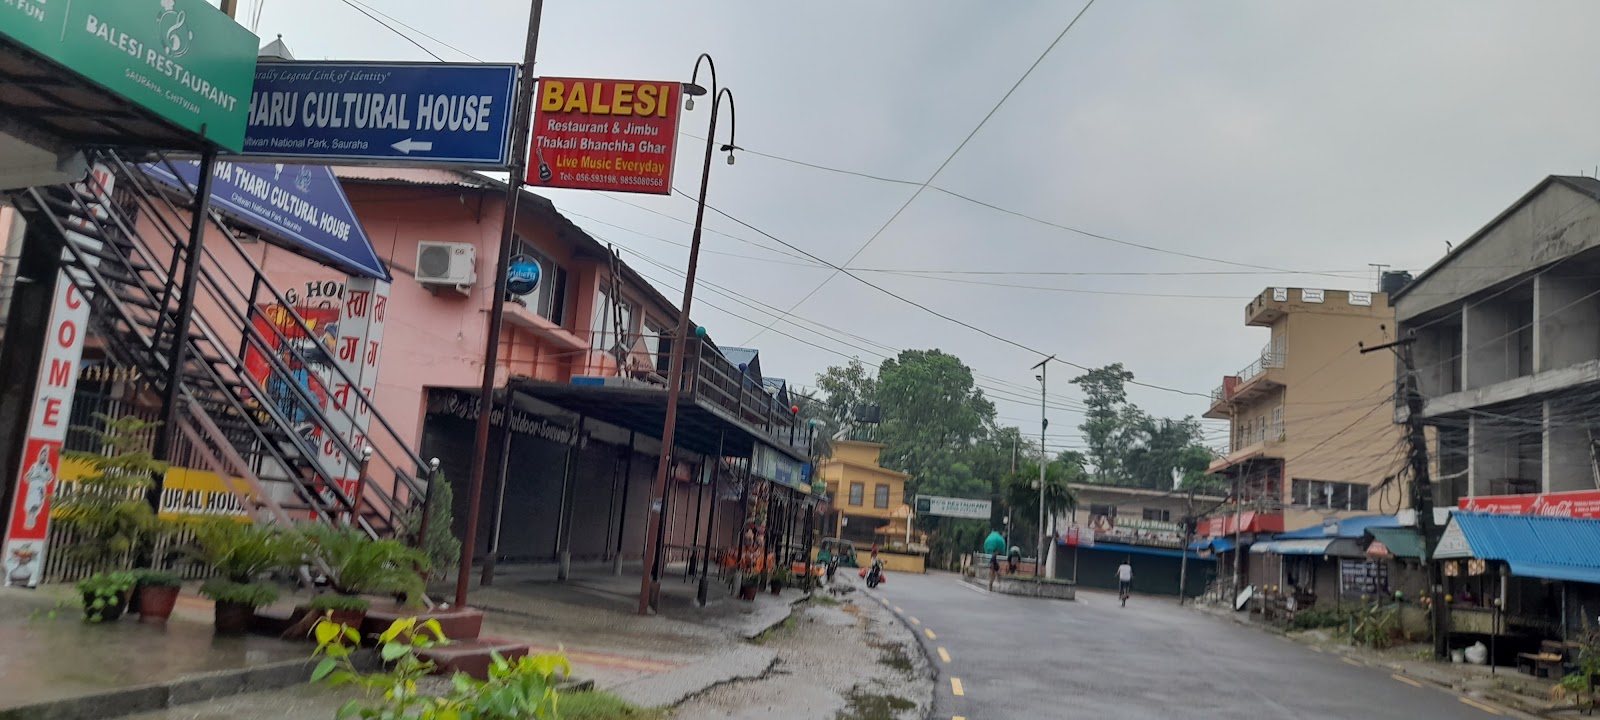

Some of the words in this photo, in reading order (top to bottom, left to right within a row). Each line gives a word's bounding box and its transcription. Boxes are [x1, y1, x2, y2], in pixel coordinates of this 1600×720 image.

[17, 0, 45, 22] FUN
[86, 14, 143, 59] BALESI
[147, 49, 238, 112] RESTAURANT
[253, 70, 278, 83] urally
[280, 69, 311, 82] Legend
[313, 70, 337, 82] Link
[337, 71, 348, 84] of
[125, 68, 164, 97] SAURAHA,
[165, 90, 201, 115] CHITWAN
[541, 80, 670, 117] BALESI
[248, 91, 299, 128] HARU
[302, 92, 411, 130] CULTURAL
[416, 94, 493, 132] HOUSE
[547, 119, 609, 134] Restaurant
[611, 122, 620, 134] &
[623, 122, 658, 136] Jimbu
[244, 136, 269, 147] hitwan
[270, 136, 306, 148] National
[307, 138, 330, 150] Park,
[331, 138, 369, 150] Sauraha
[536, 136, 577, 149] Thakali
[580, 137, 635, 152] Bhanchha
[638, 140, 667, 154] Ghar
[556, 155, 579, 168] Live
[581, 156, 612, 170] Music
[615, 157, 665, 177] Everyday
[235, 166, 270, 201] THARU
[270, 186, 319, 226] CULTURAL
[319, 212, 352, 242] HOUSE
[251, 200, 272, 220] National
